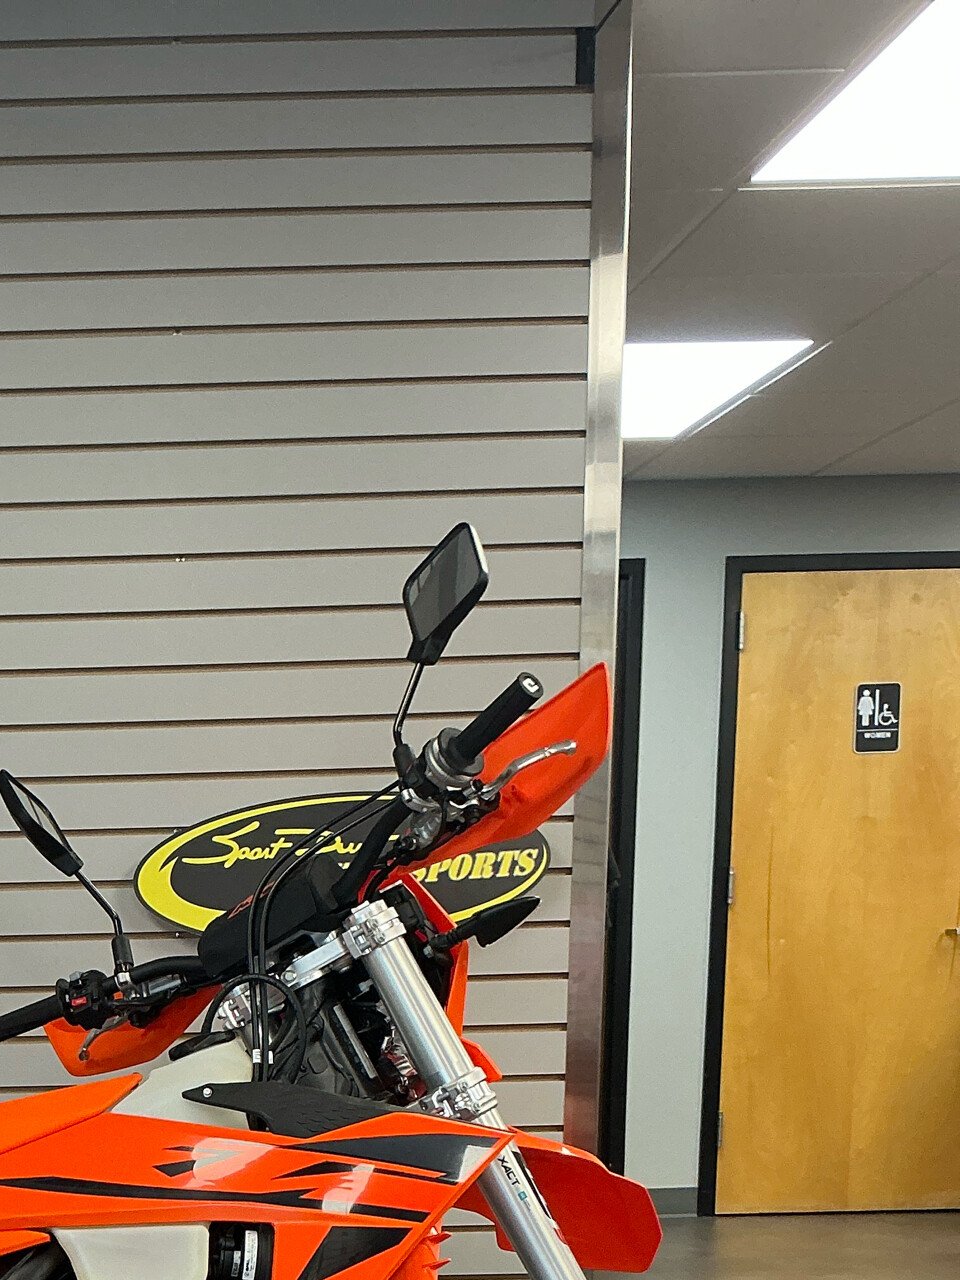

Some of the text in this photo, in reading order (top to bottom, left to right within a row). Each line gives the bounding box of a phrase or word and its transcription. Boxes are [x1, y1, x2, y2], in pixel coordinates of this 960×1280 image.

[863, 731, 892, 739] WOMEN
[181, 820, 294, 869] Sport
[497, 1154, 521, 1186] XACT
